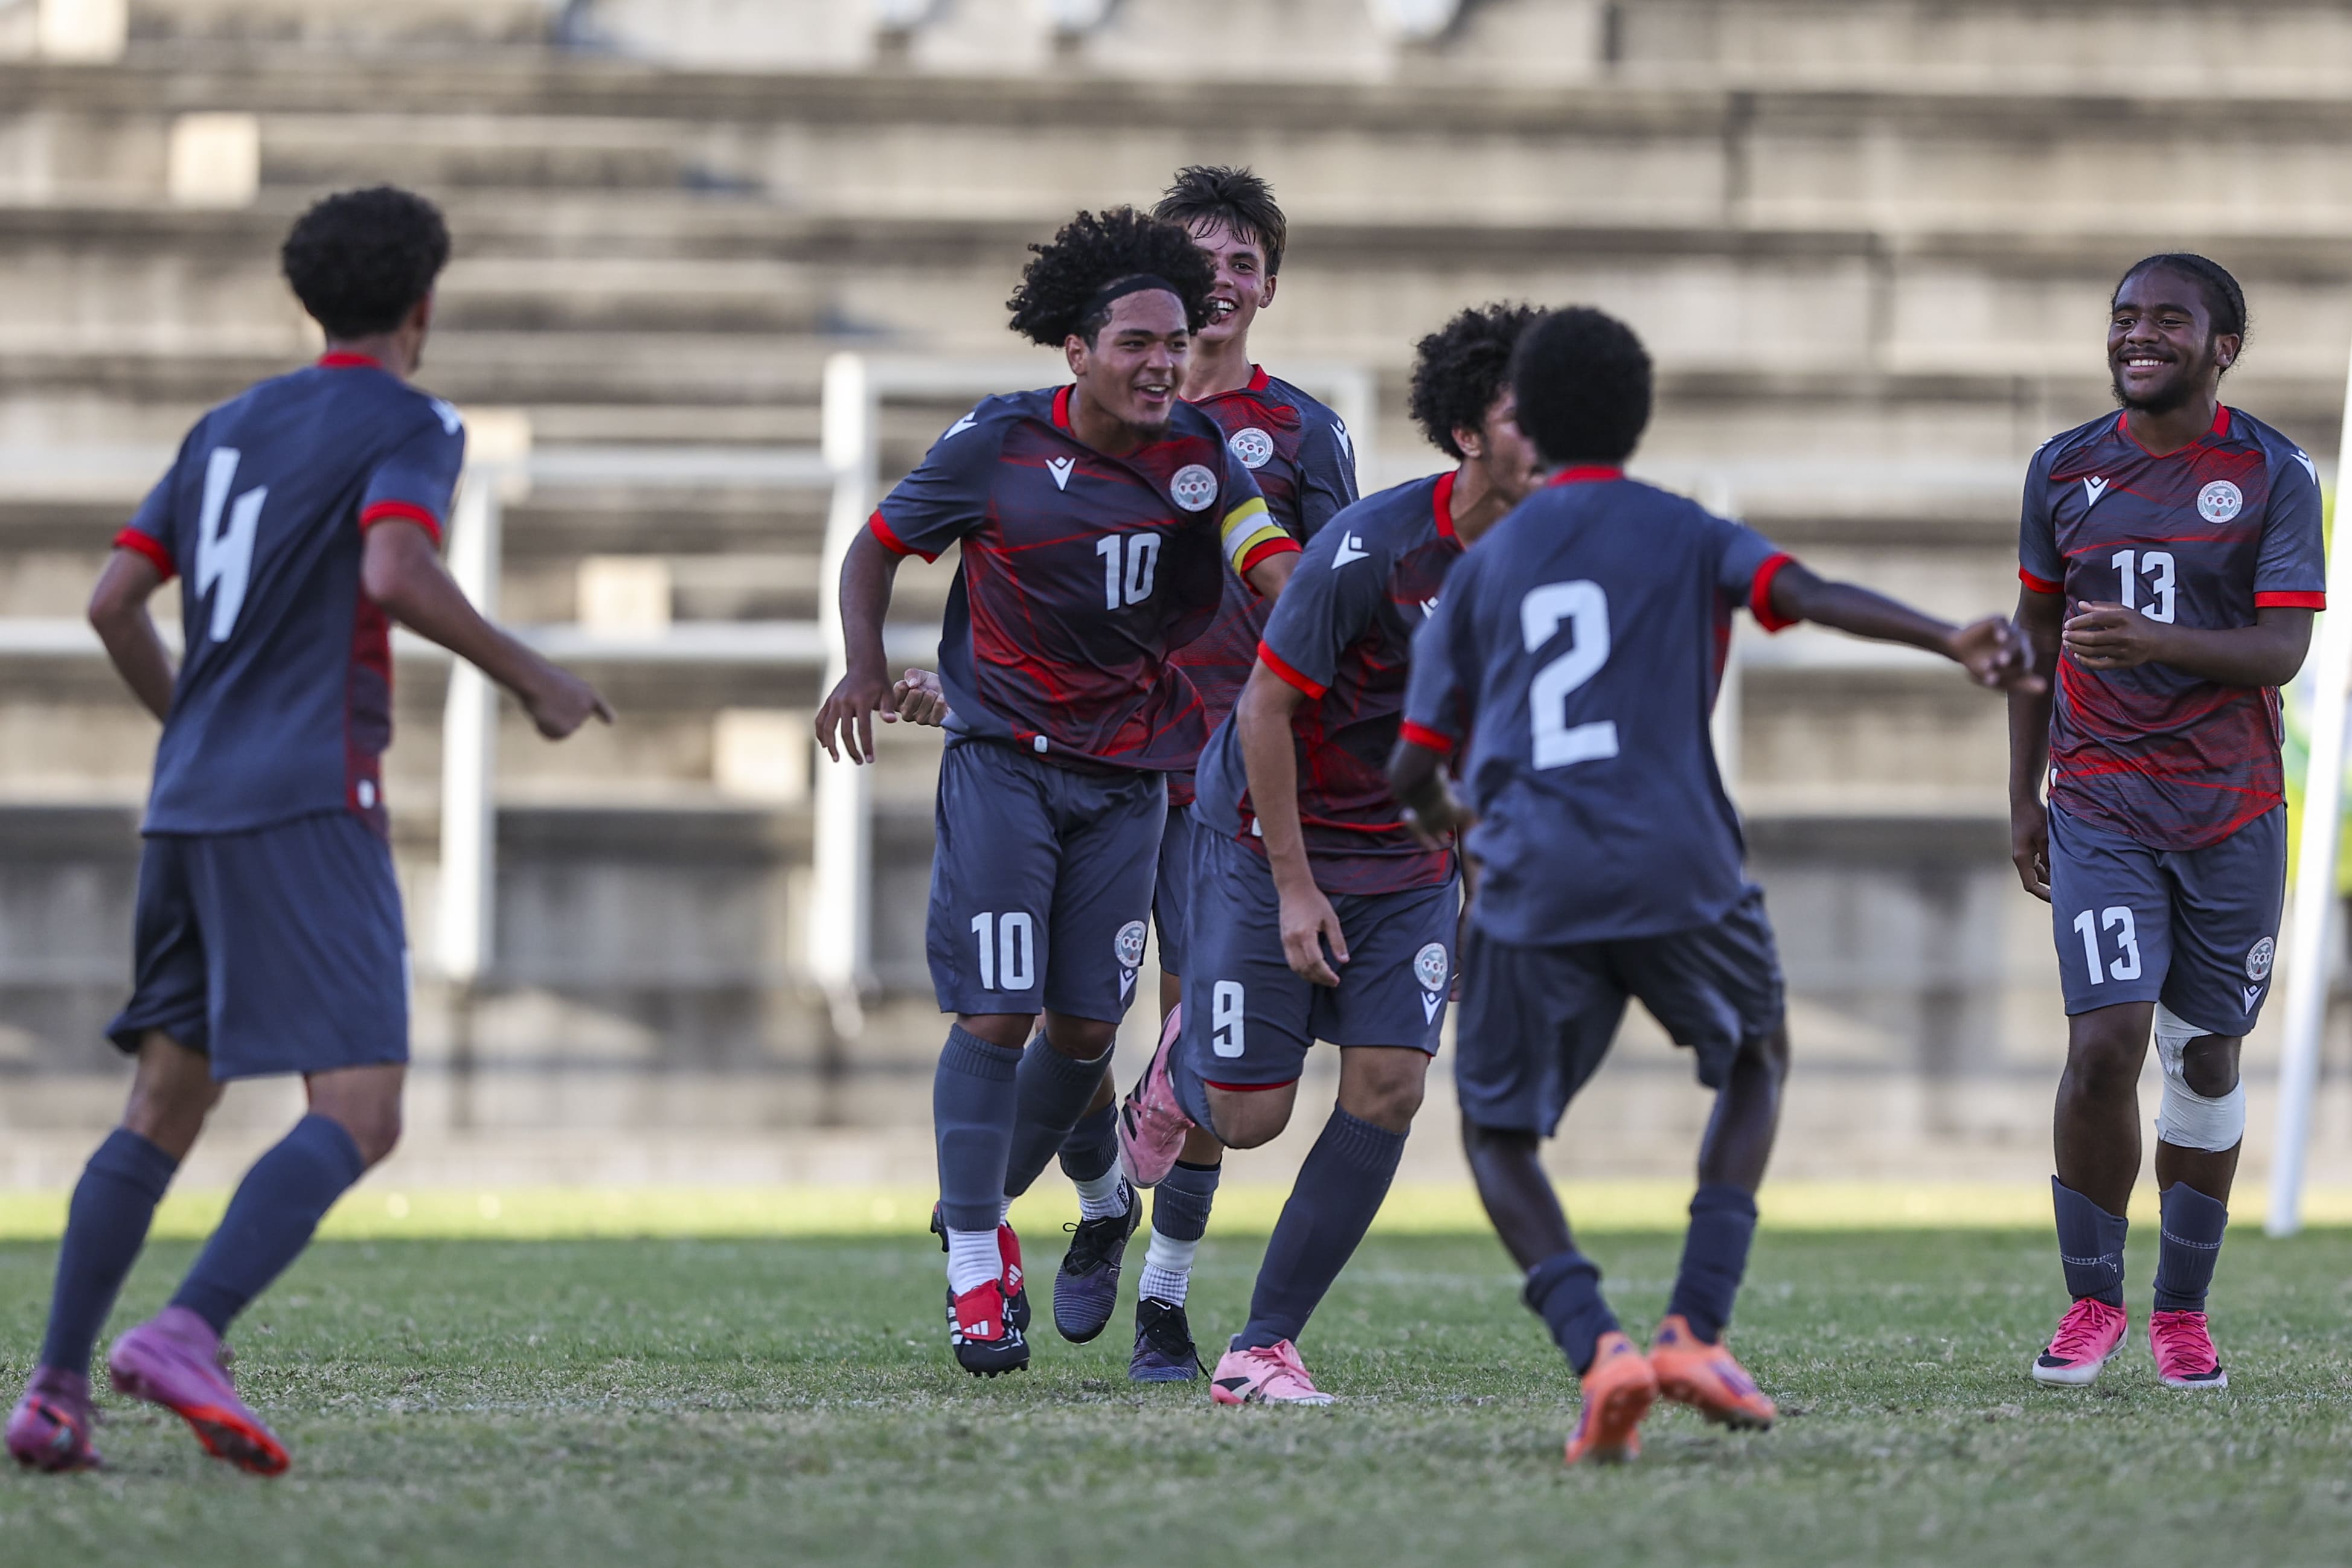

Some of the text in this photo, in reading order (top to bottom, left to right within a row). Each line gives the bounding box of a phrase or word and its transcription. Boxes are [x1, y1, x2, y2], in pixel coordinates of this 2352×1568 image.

[195, 447, 267, 641] 4
[1096, 533, 1161, 610] 10
[2111, 549, 2176, 625] 13
[1520, 580, 1620, 770] 2
[971, 911, 1035, 990] 10
[2073, 905, 2142, 985] 13
[1212, 979, 1245, 1058] 9
